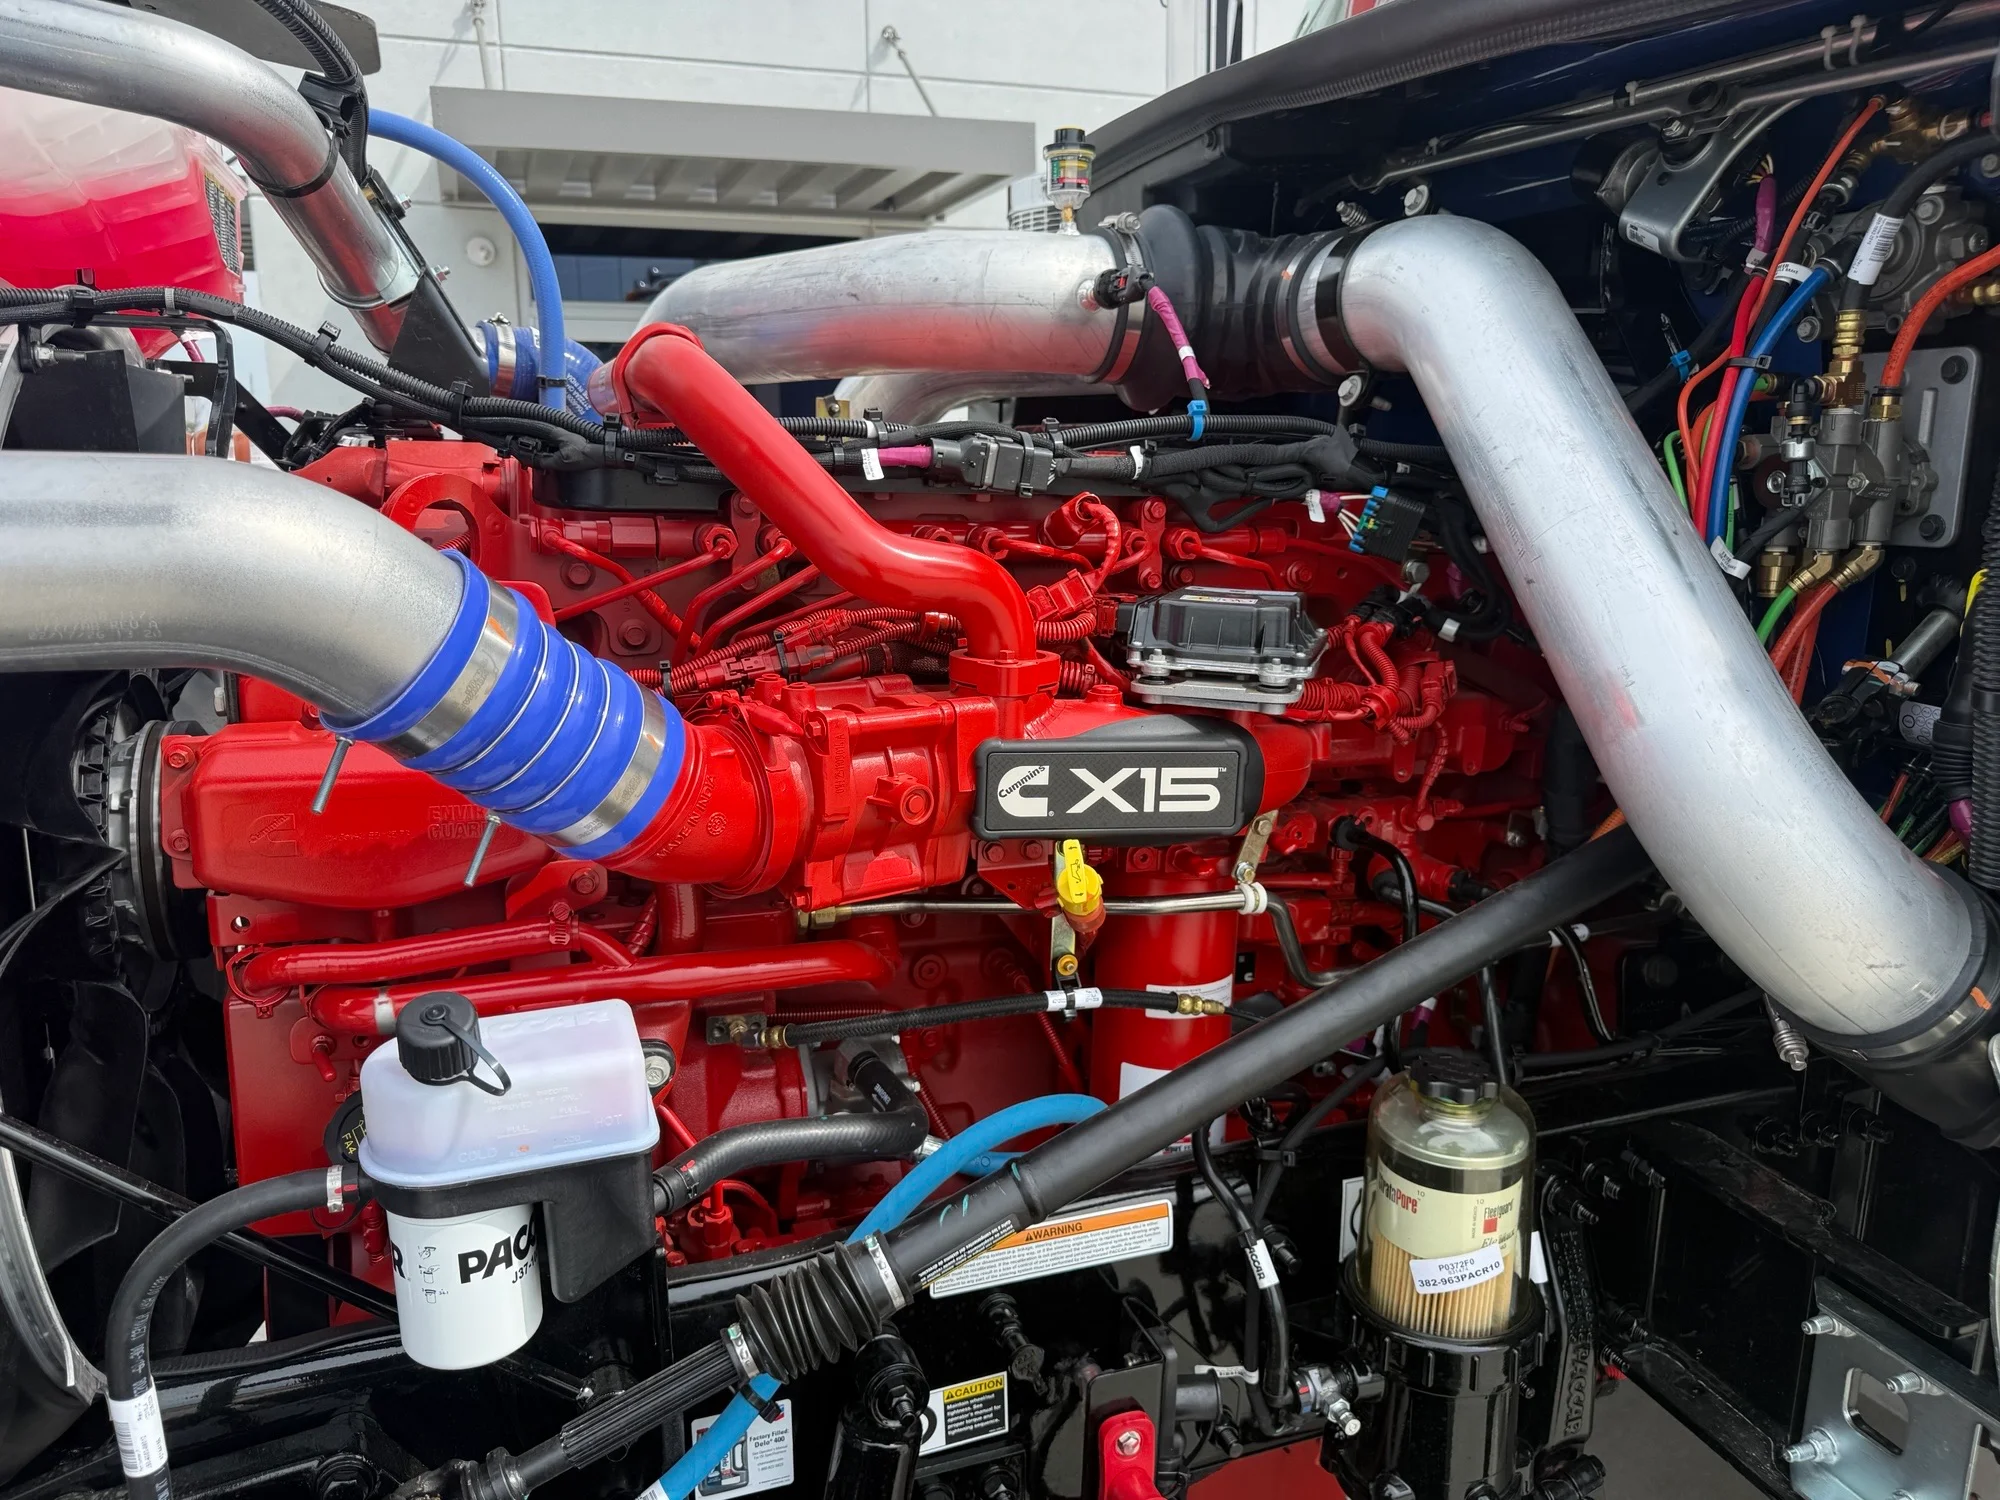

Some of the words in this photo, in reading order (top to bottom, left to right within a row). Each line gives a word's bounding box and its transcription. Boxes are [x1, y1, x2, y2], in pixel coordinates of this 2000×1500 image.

[998, 764, 1046, 799] Cummins
[428, 804, 488, 822] ENVIR
[656, 827, 692, 860] MADE
[687, 810, 701, 828] IN
[696, 774, 717, 813] INDIA
[427, 821, 486, 839] GUAR
[1031, 1222, 1083, 1240] WARNING
[457, 1211, 538, 1285] PACC
[1417, 1261, 1501, 1288] 382-963PACR10
[955, 1378, 1003, 1397] CAUTION
[1564, 1343, 1590, 1437] PACCAR
[749, 1432, 770, 1442] Factory
